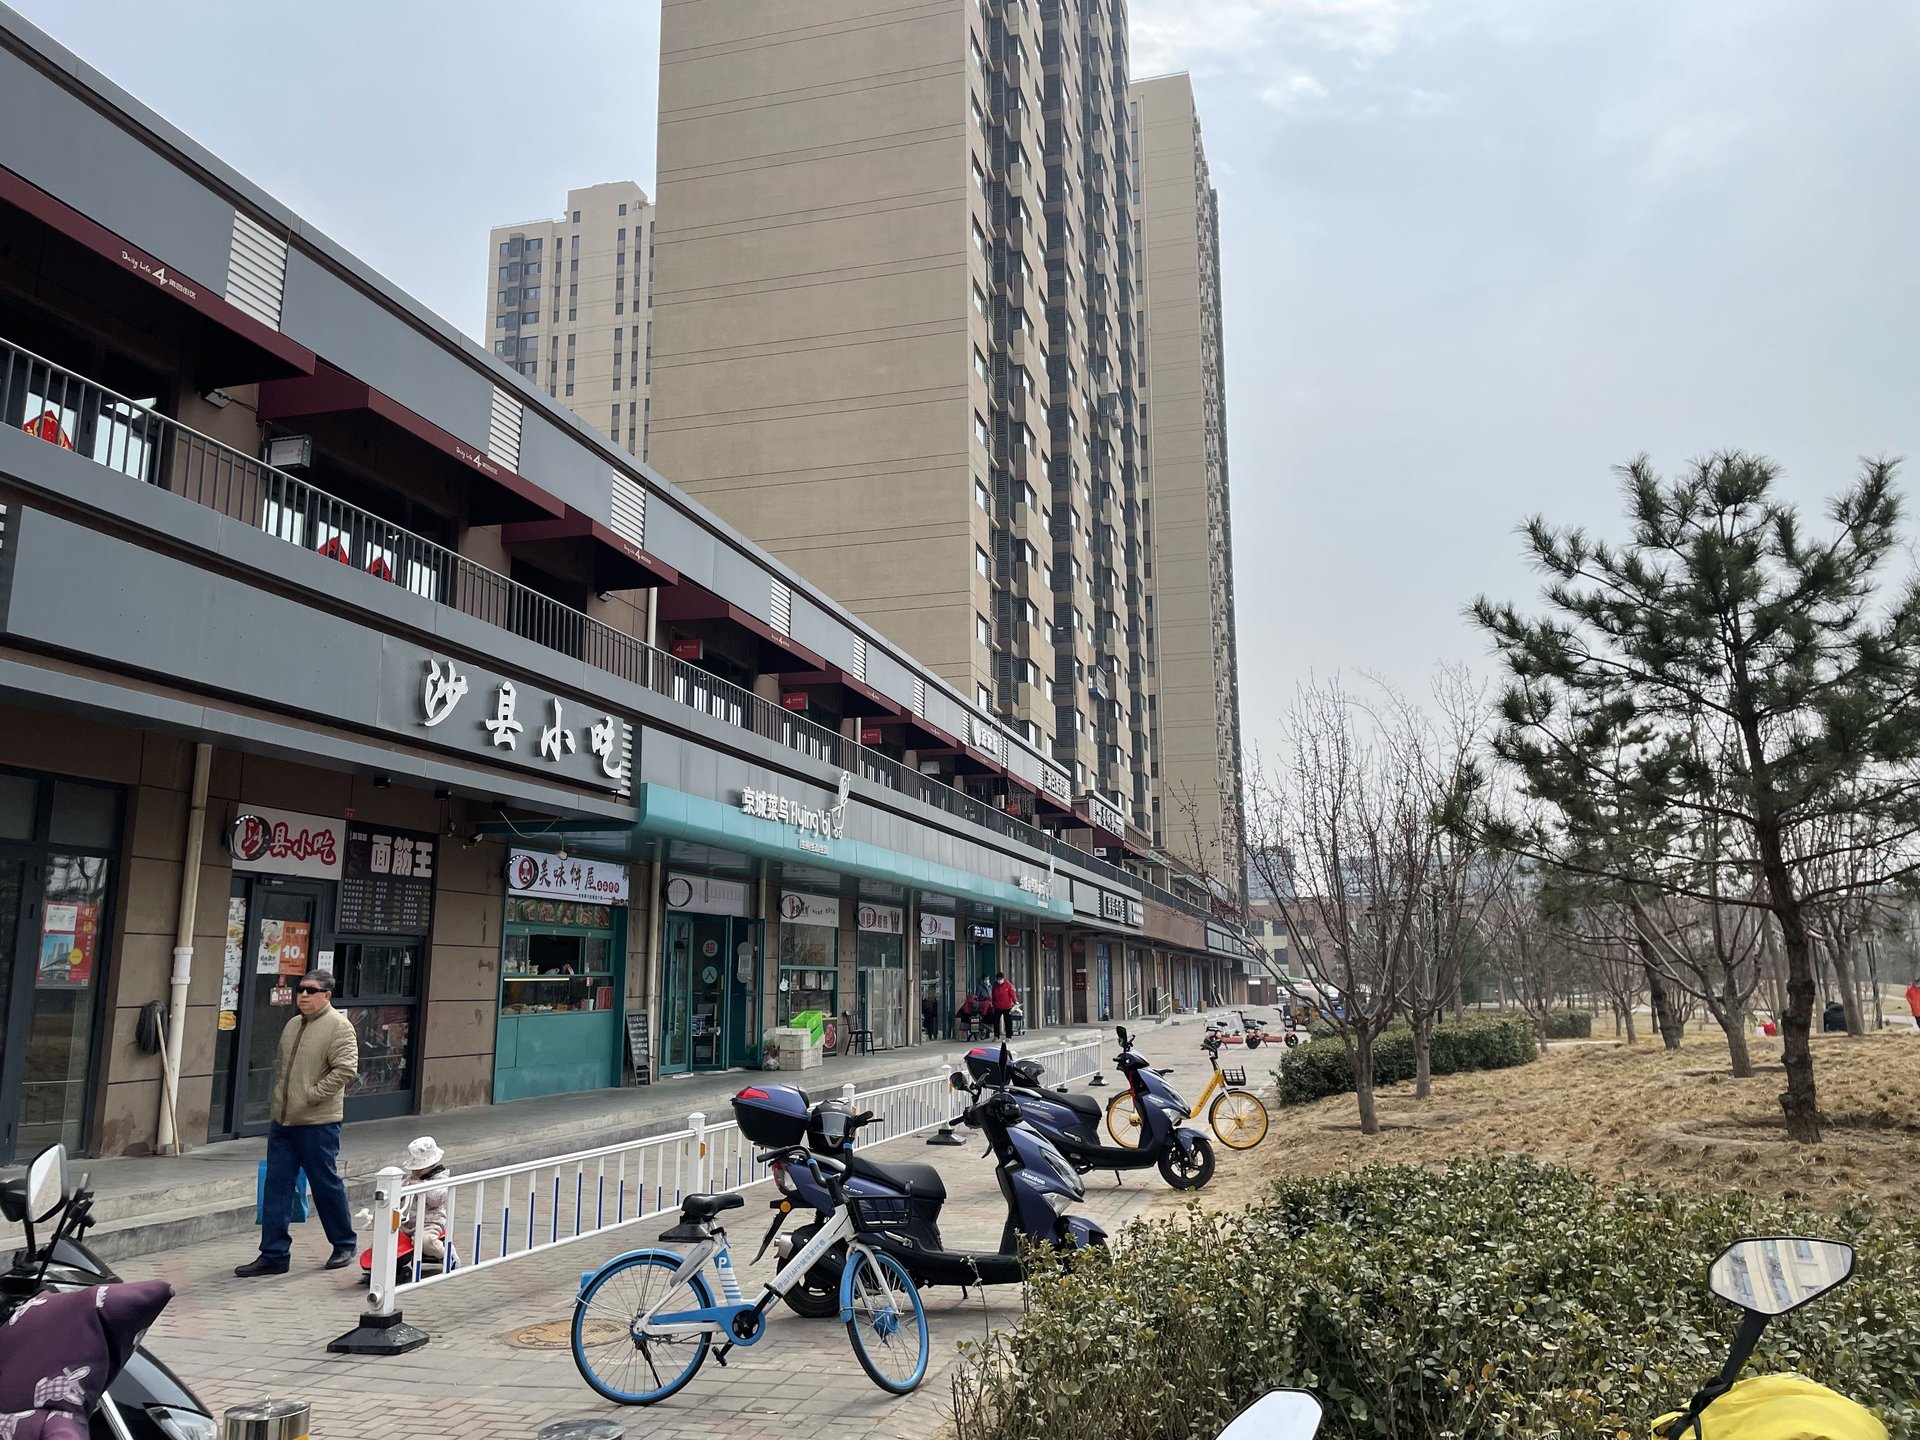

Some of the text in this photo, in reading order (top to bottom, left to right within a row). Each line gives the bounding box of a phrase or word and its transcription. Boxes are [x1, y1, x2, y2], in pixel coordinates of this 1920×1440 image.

[420, 659, 622, 779] 沙县小吃
[742, 787, 789, 824] 京城菜鸟
[242, 818, 337, 866] 沙县小吃
[370, 834, 433, 878] 面筋王
